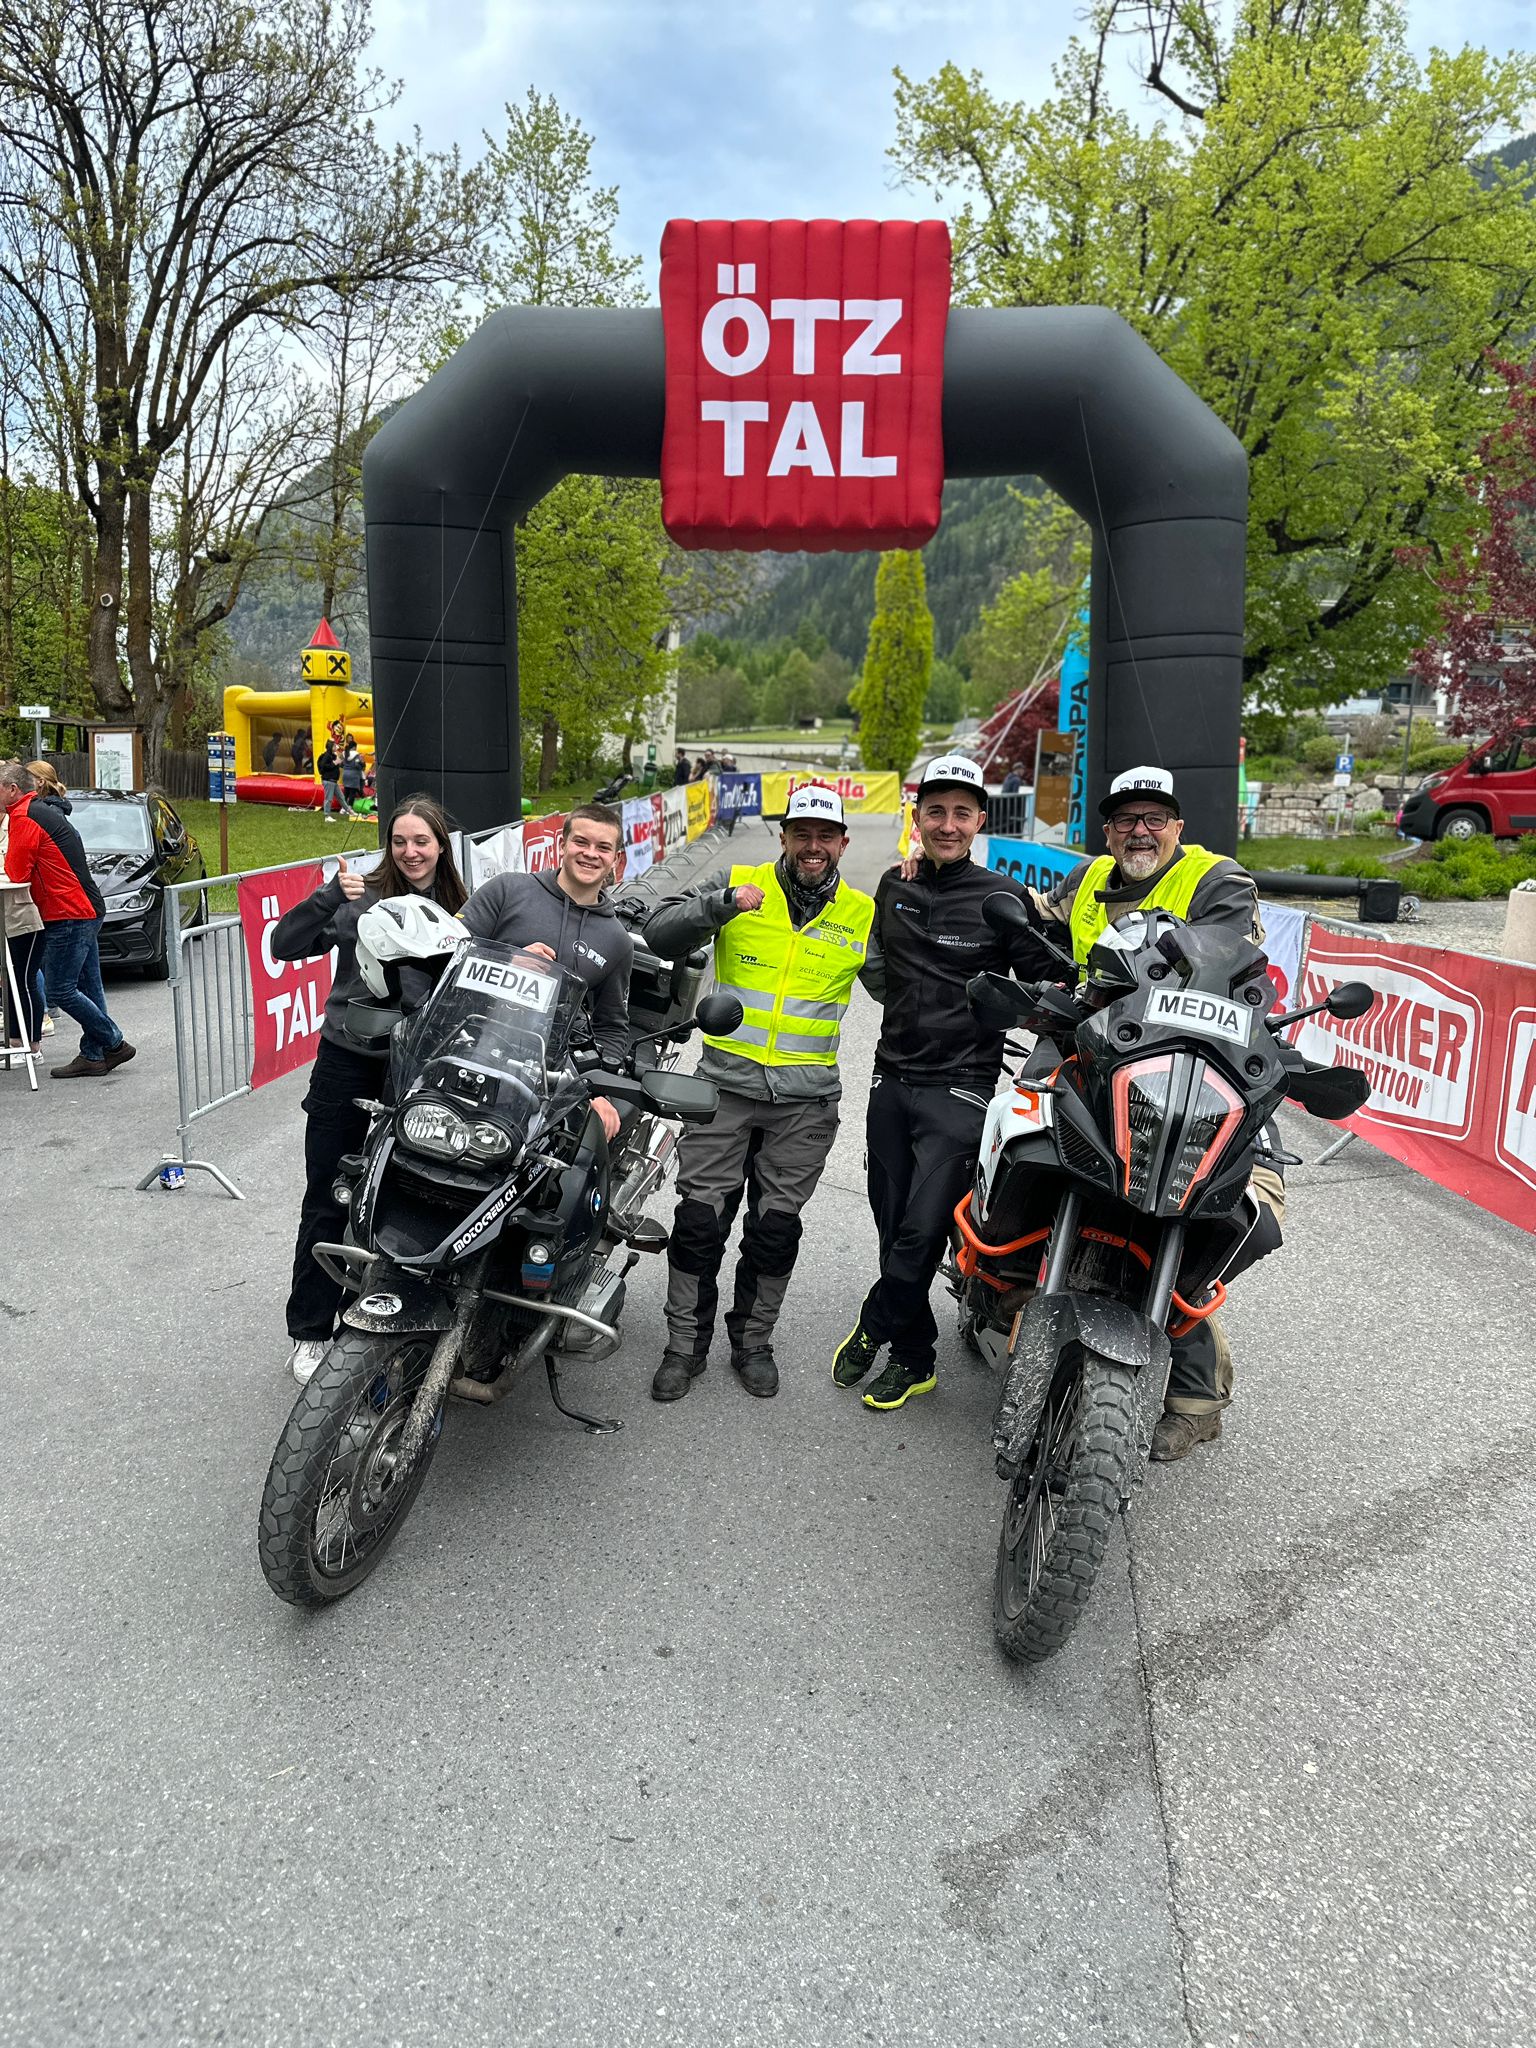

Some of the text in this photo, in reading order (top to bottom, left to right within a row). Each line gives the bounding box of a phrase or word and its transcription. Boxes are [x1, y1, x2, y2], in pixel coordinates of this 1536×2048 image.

[701, 263, 902, 376] ÖTZ
[701, 400, 897, 477] TAL
[1339, 756, 1350, 769] P
[735, 953, 758, 963] VTR
[937, 939, 981, 948] AMBASSADOR
[466, 961, 540, 1000] MEDIA
[266, 980, 325, 1052] TAL
[1158, 994, 1239, 1031] MEDIA
[1332, 1044, 1424, 1110] NUTRITION
[452, 1184, 518, 1254] MOTOCREW.CH
